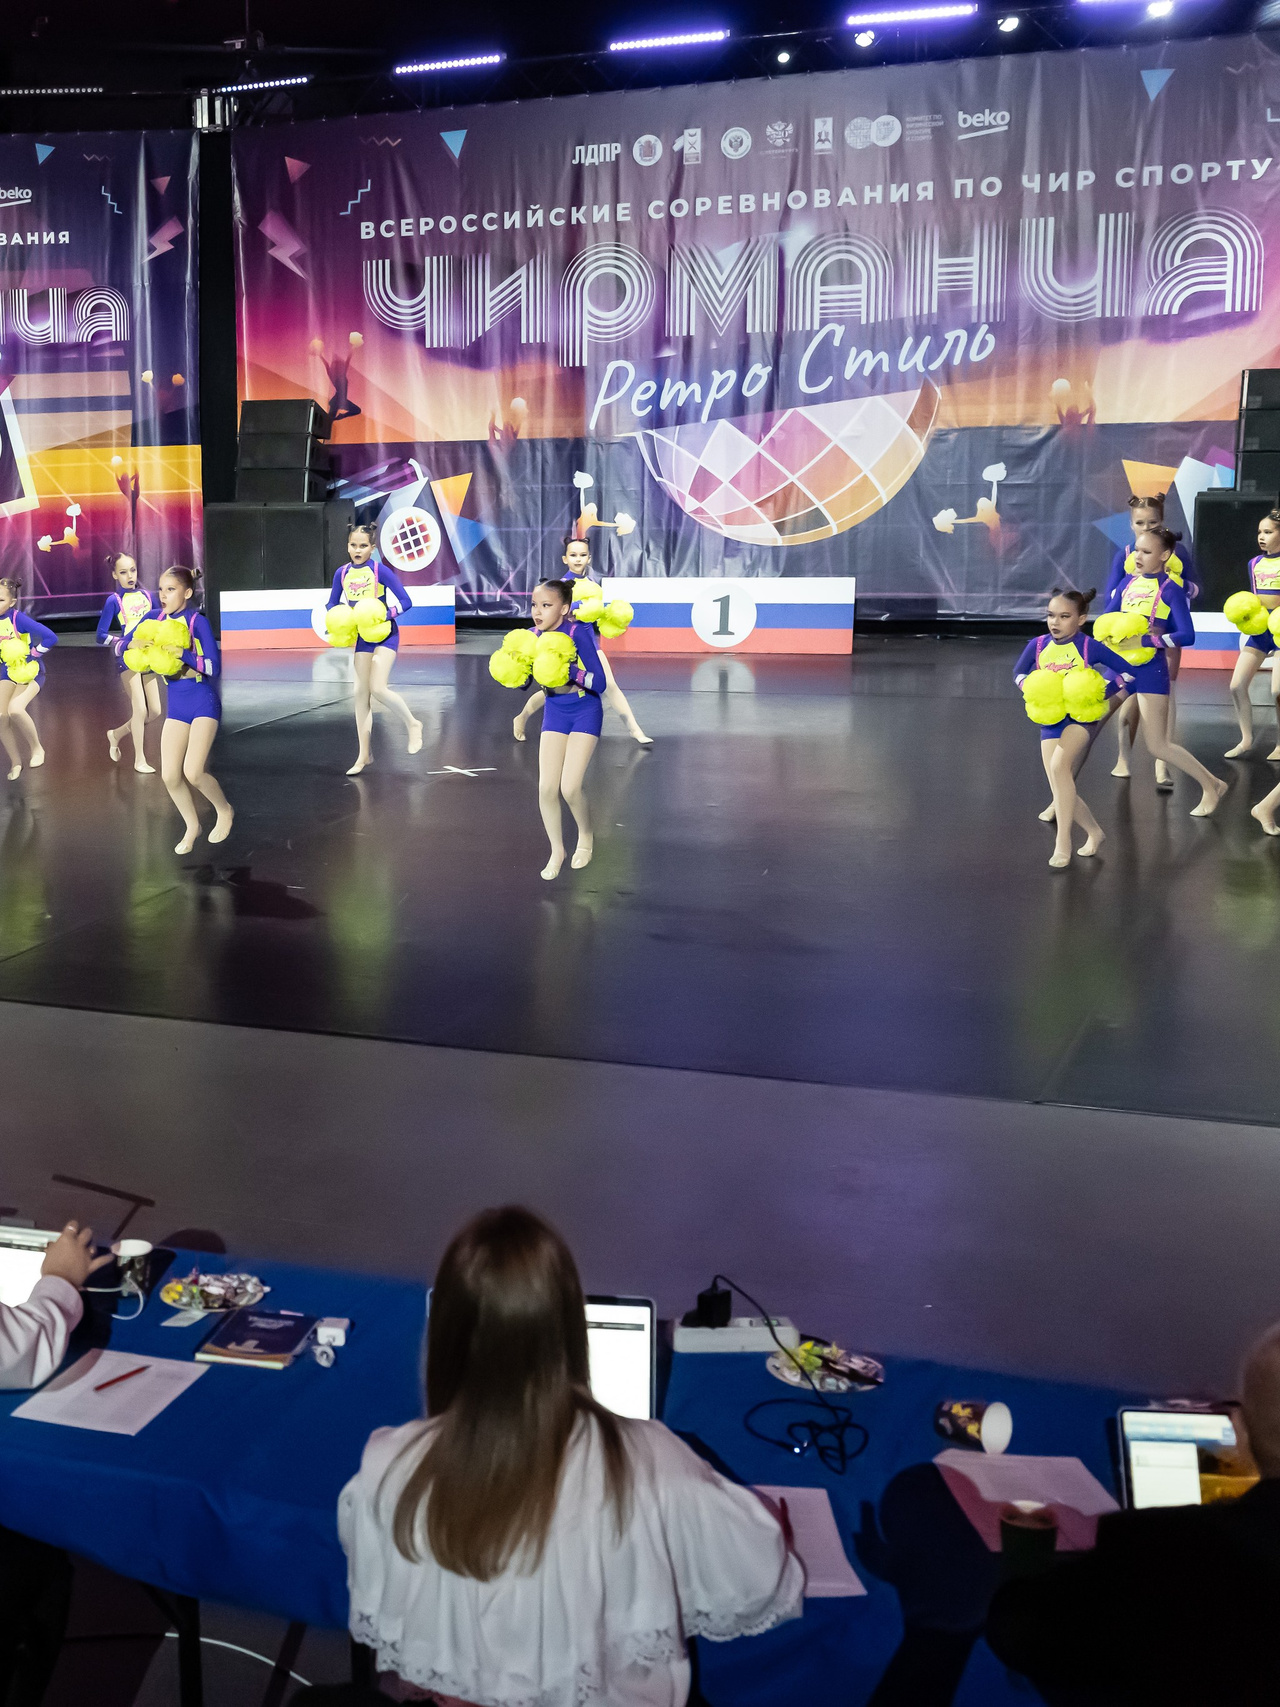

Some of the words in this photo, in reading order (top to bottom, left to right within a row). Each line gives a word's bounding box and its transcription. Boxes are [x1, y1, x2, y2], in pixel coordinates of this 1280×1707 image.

[958, 109, 1010, 128] beko
[572, 143, 622, 166] ЛДПР
[360, 203, 631, 240] ВСЕРОССИЙСКИЕ
[648, 181, 934, 219] СОРЕВНОВАНИЯ
[954, 177, 1003, 199] ПО
[1022, 170, 1096, 193] ЧИР
[1115, 158, 1273, 188] СПОРТУ
[588, 360, 773, 429] Ретро
[798, 323, 996, 394] Стиль
[712, 595, 736, 636] 1
